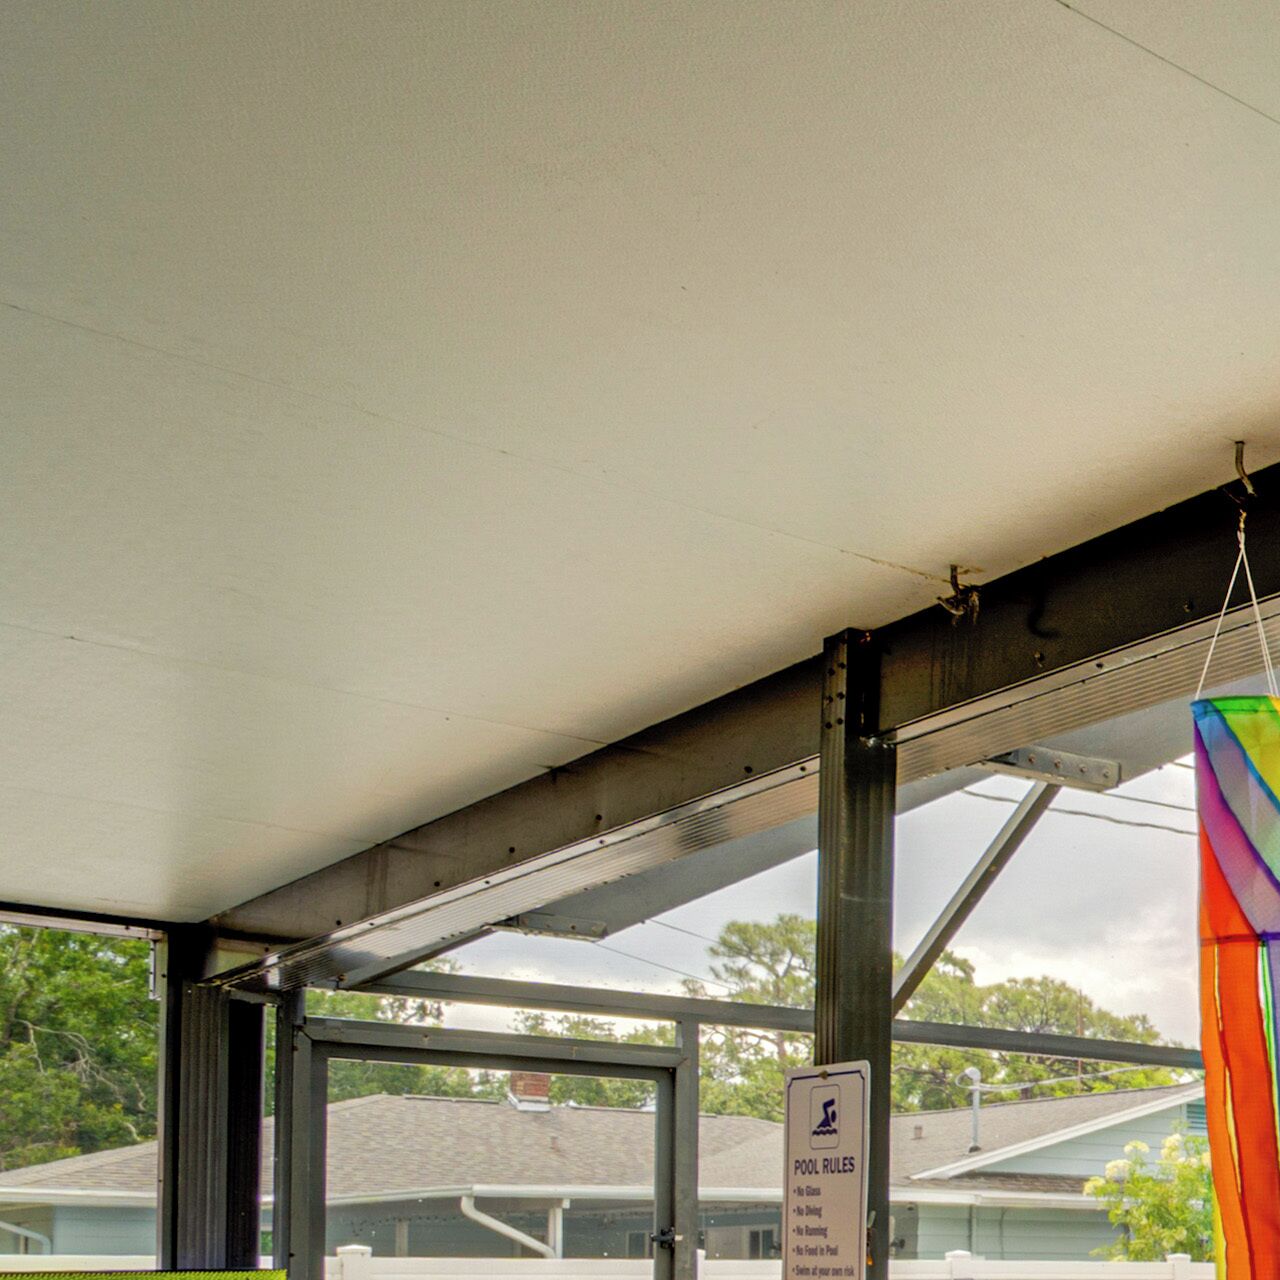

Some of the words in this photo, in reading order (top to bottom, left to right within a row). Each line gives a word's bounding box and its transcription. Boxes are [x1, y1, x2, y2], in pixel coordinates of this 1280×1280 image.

[794, 1158, 819, 1175] POOL
[822, 1156, 855, 1174] RULES
[797, 1186, 804, 1196] No
[806, 1185, 821, 1196] Glass
[797, 1205, 804, 1216] No
[806, 1205, 822, 1218] Diving
[796, 1225, 803, 1236] No
[805, 1225, 828, 1238] Running
[796, 1245, 803, 1256] No
[804, 1244, 818, 1256] Food
[826, 1244, 838, 1256] Pool
[796, 1265, 810, 1276] Swim
